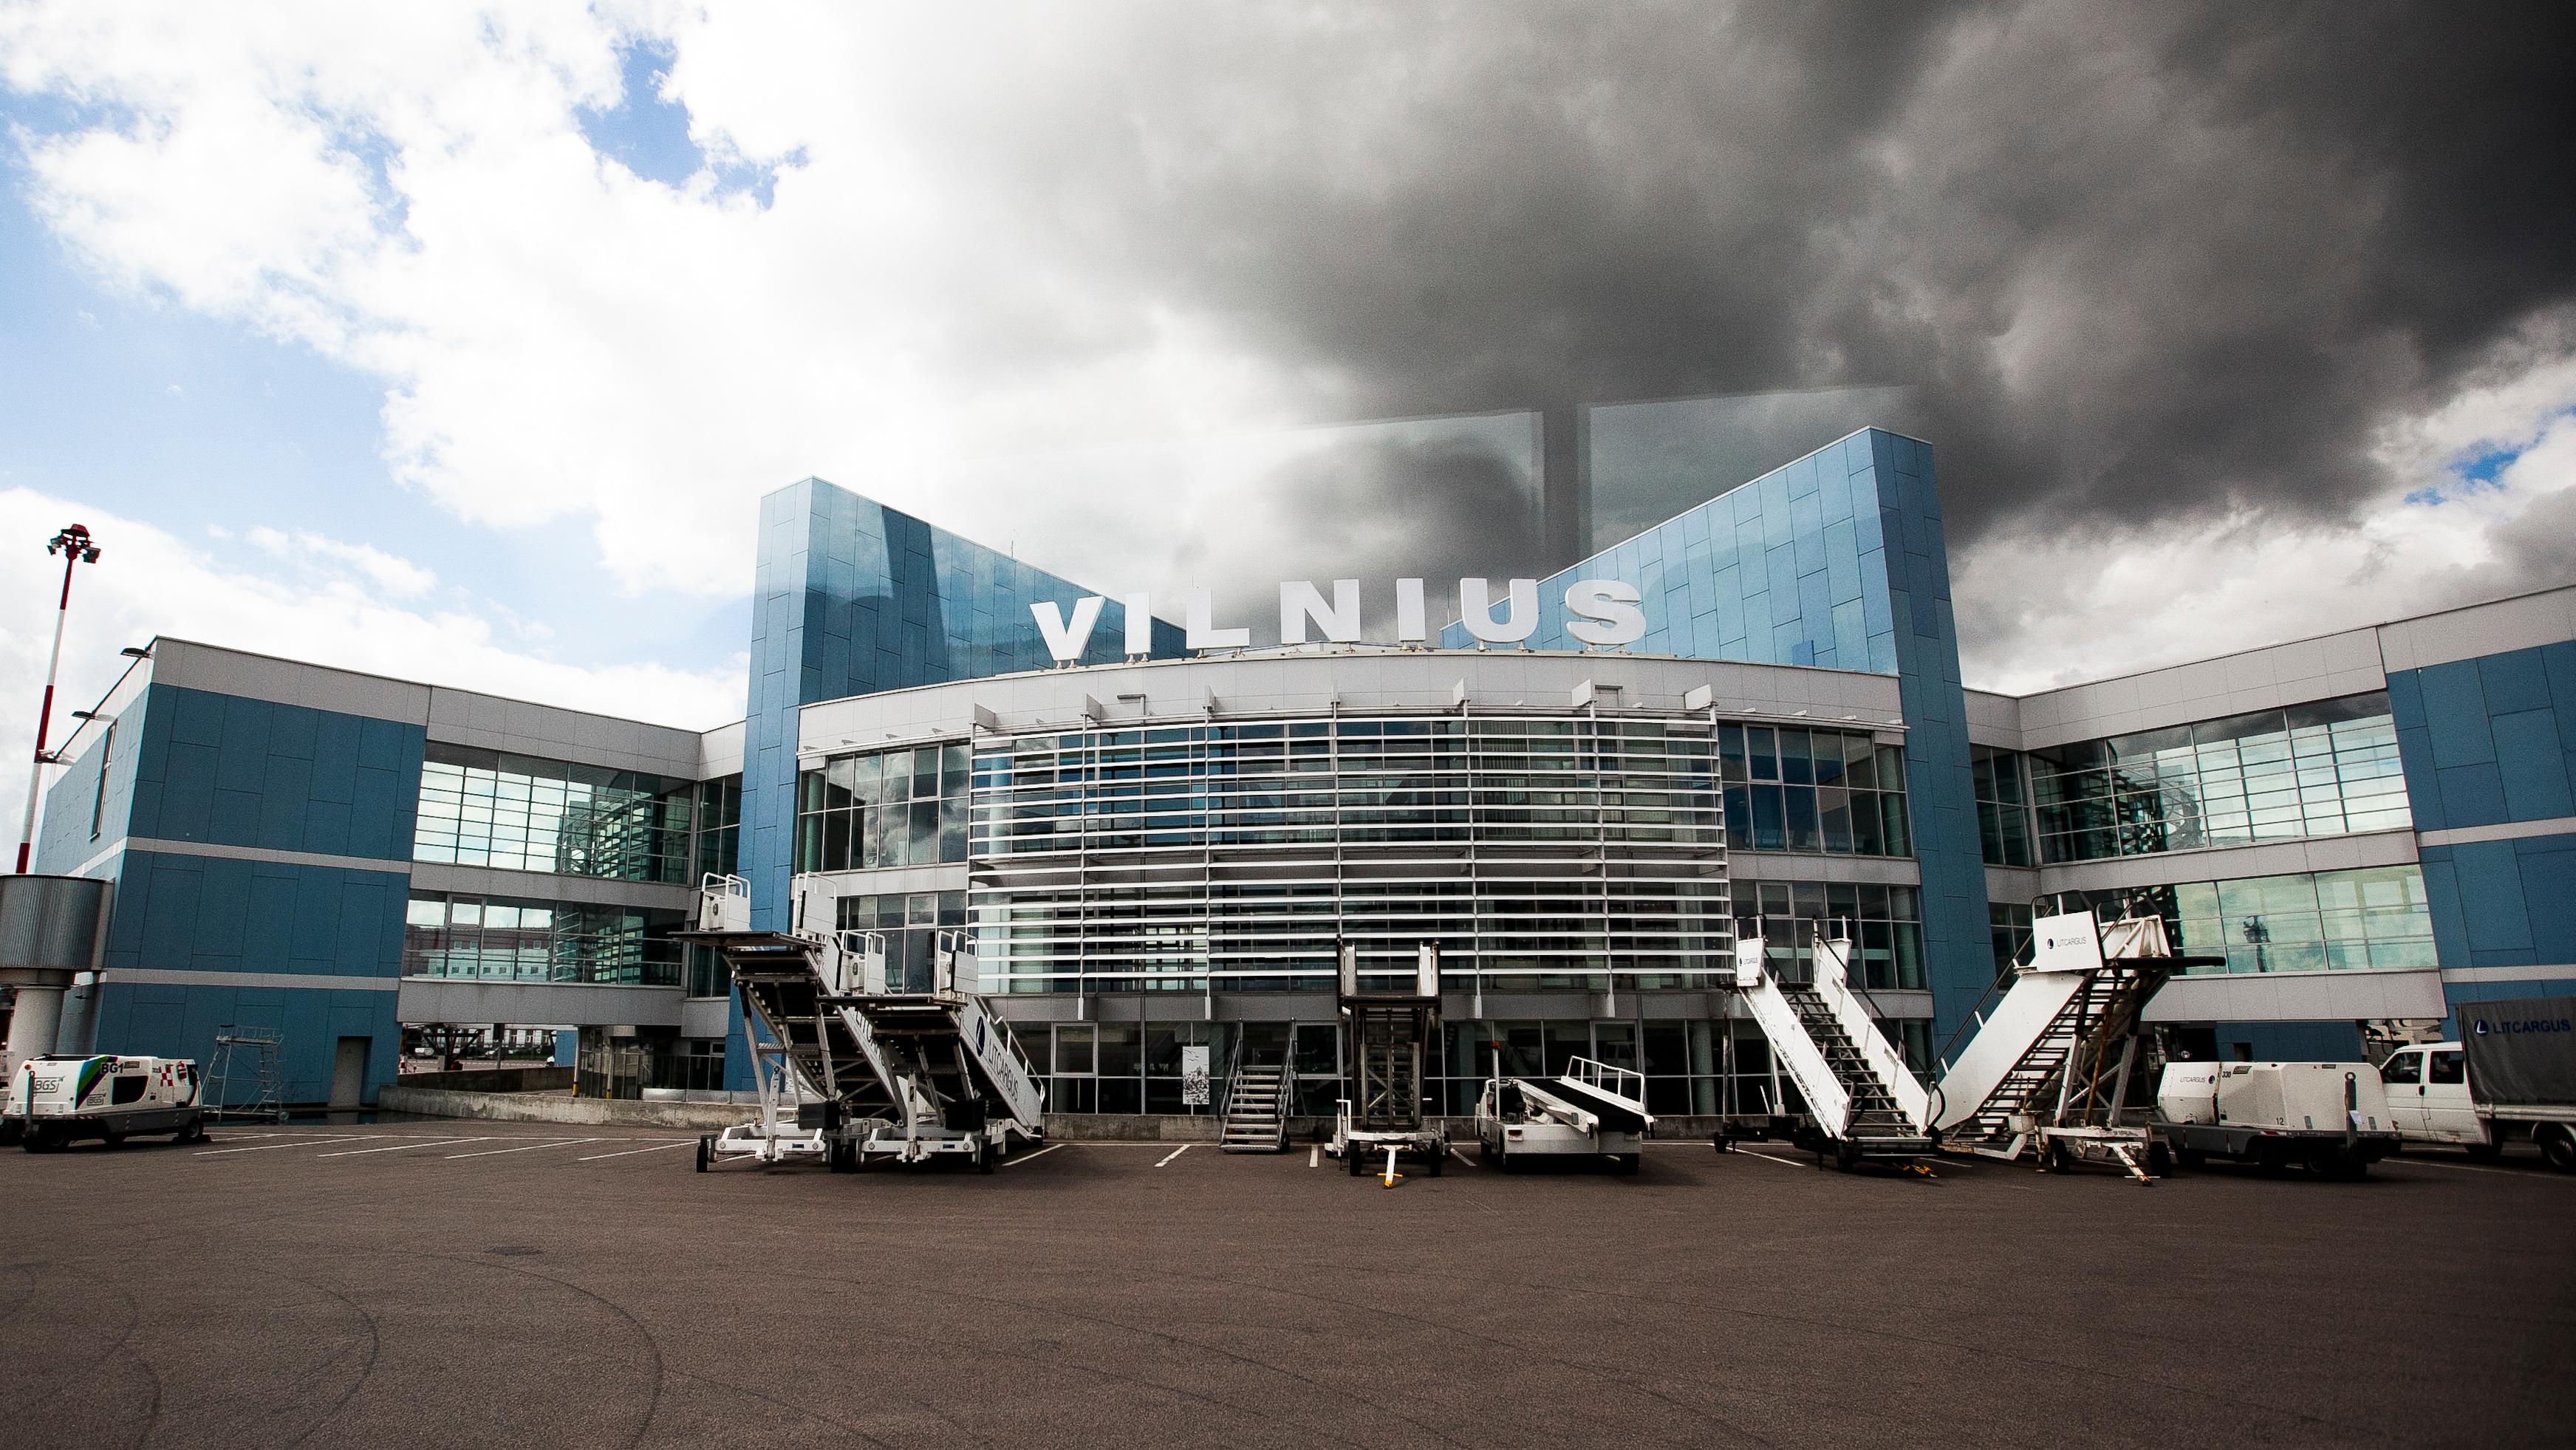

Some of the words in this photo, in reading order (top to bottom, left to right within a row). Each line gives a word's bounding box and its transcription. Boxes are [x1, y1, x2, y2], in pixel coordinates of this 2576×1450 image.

[1030, 577, 1647, 661] VILNIUS
[2056, 937, 2087, 948] LITCARGUS
[2493, 1019, 2571, 1034] LITCARGUS
[100, 1063, 124, 1074] BG1
[988, 1037, 1019, 1103] LITCARGUS
[35, 1080, 57, 1090] BGS
[88, 1095, 103, 1104] BGS
[2275, 1117, 2285, 1126] 12
